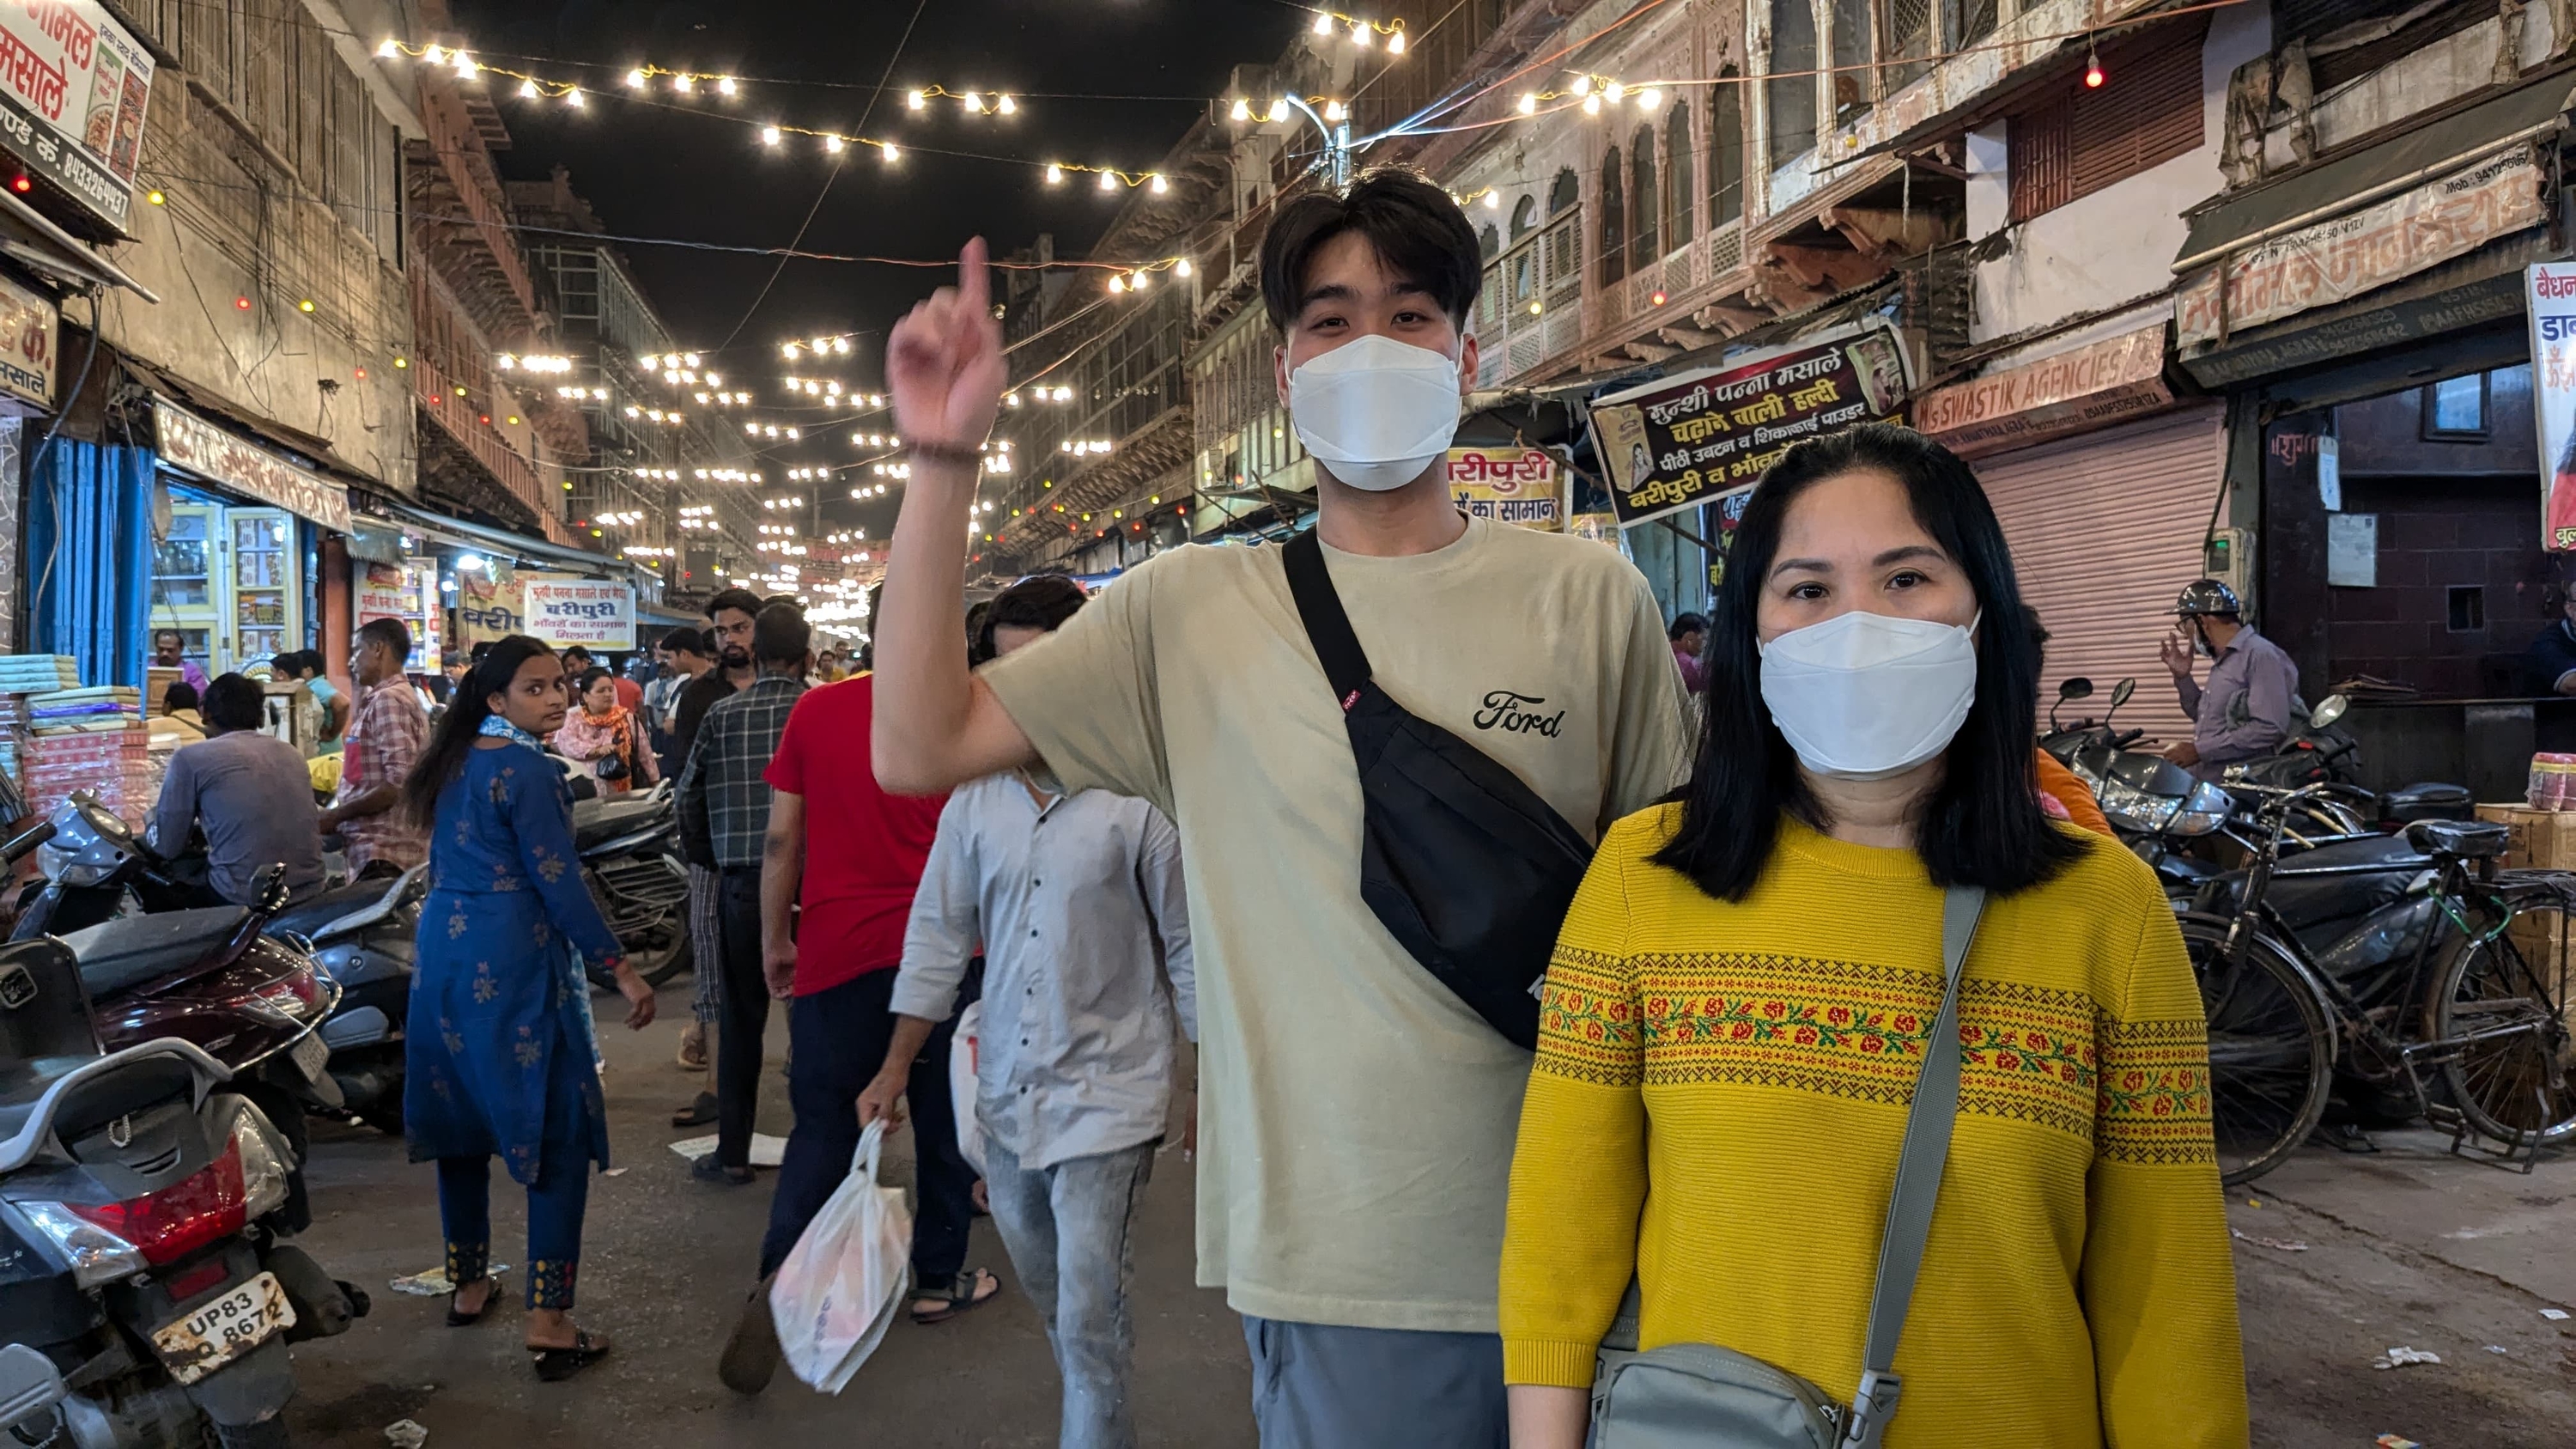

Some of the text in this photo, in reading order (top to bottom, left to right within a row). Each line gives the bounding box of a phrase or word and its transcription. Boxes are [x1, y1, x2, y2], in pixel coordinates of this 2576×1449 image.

[64, 152, 129, 219] 8433264437
[2445, 179, 2470, 195] Mob
[1646, 346, 1843, 425] मुन्शी पन्ना मसाले
[1788, 378, 1841, 412] हल्दी
[1941, 378, 2016, 427] SWASTIK
[2020, 348, 2123, 409] AGENCIES
[1659, 448, 1691, 472] पीठी
[1692, 438, 1736, 463] उबटन
[1820, 402, 1866, 425] पाउडर
[1500, 498, 1557, 521] सामान
[1627, 469, 1704, 508] बरीपुरी
[1706, 466, 1727, 484] व
[545, 602, 616, 619] बरीपुरी
[1473, 690, 1565, 739] Ford
[185, 1291, 253, 1337] UP83
[196, 1300, 284, 1359] Q 8672
